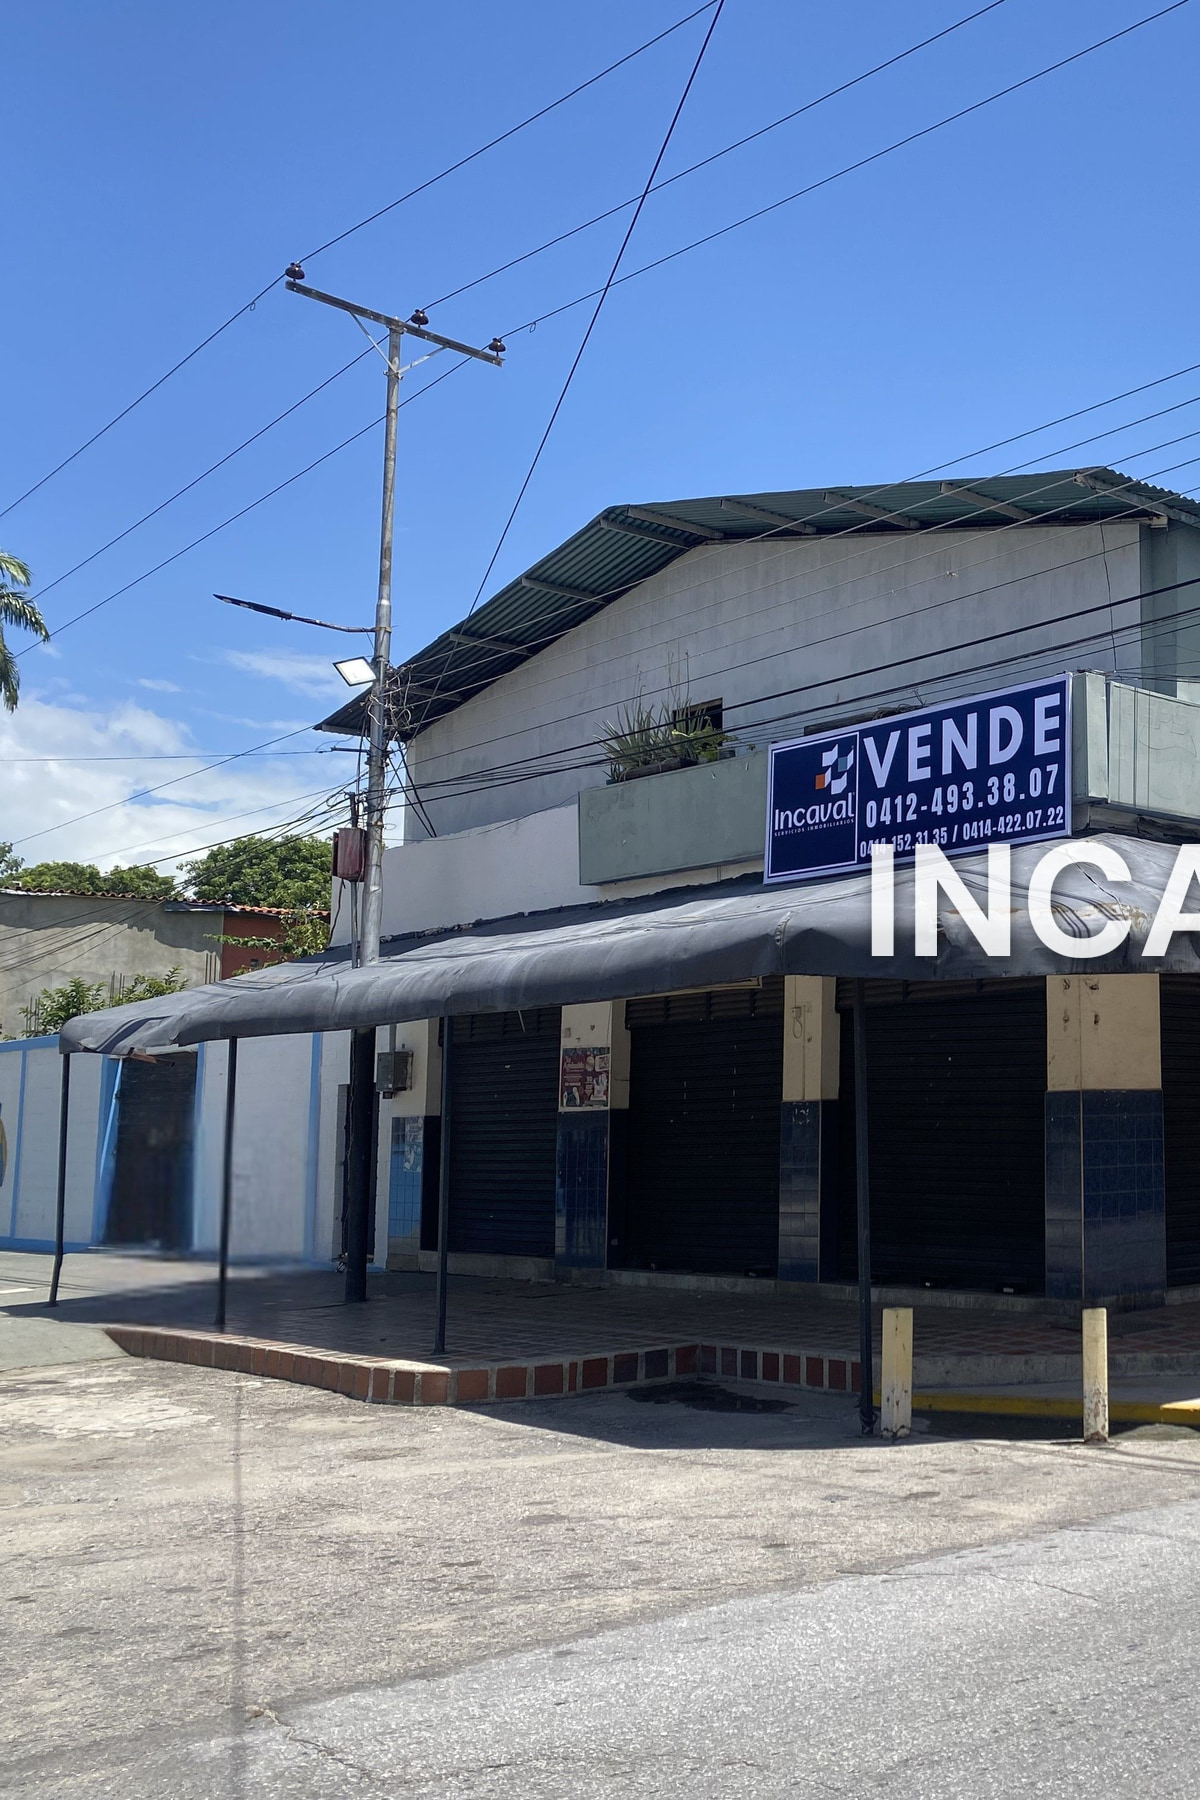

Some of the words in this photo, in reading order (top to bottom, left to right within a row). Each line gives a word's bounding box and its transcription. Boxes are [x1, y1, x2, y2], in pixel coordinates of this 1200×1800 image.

[863, 692, 1061, 789] VENDE
[774, 792, 854, 831] Incaval
[865, 763, 1059, 828] 0412-493.38.07
[774, 826, 805, 837] SERVICIOS
[963, 805, 1064, 841] 0414-422.07.22
